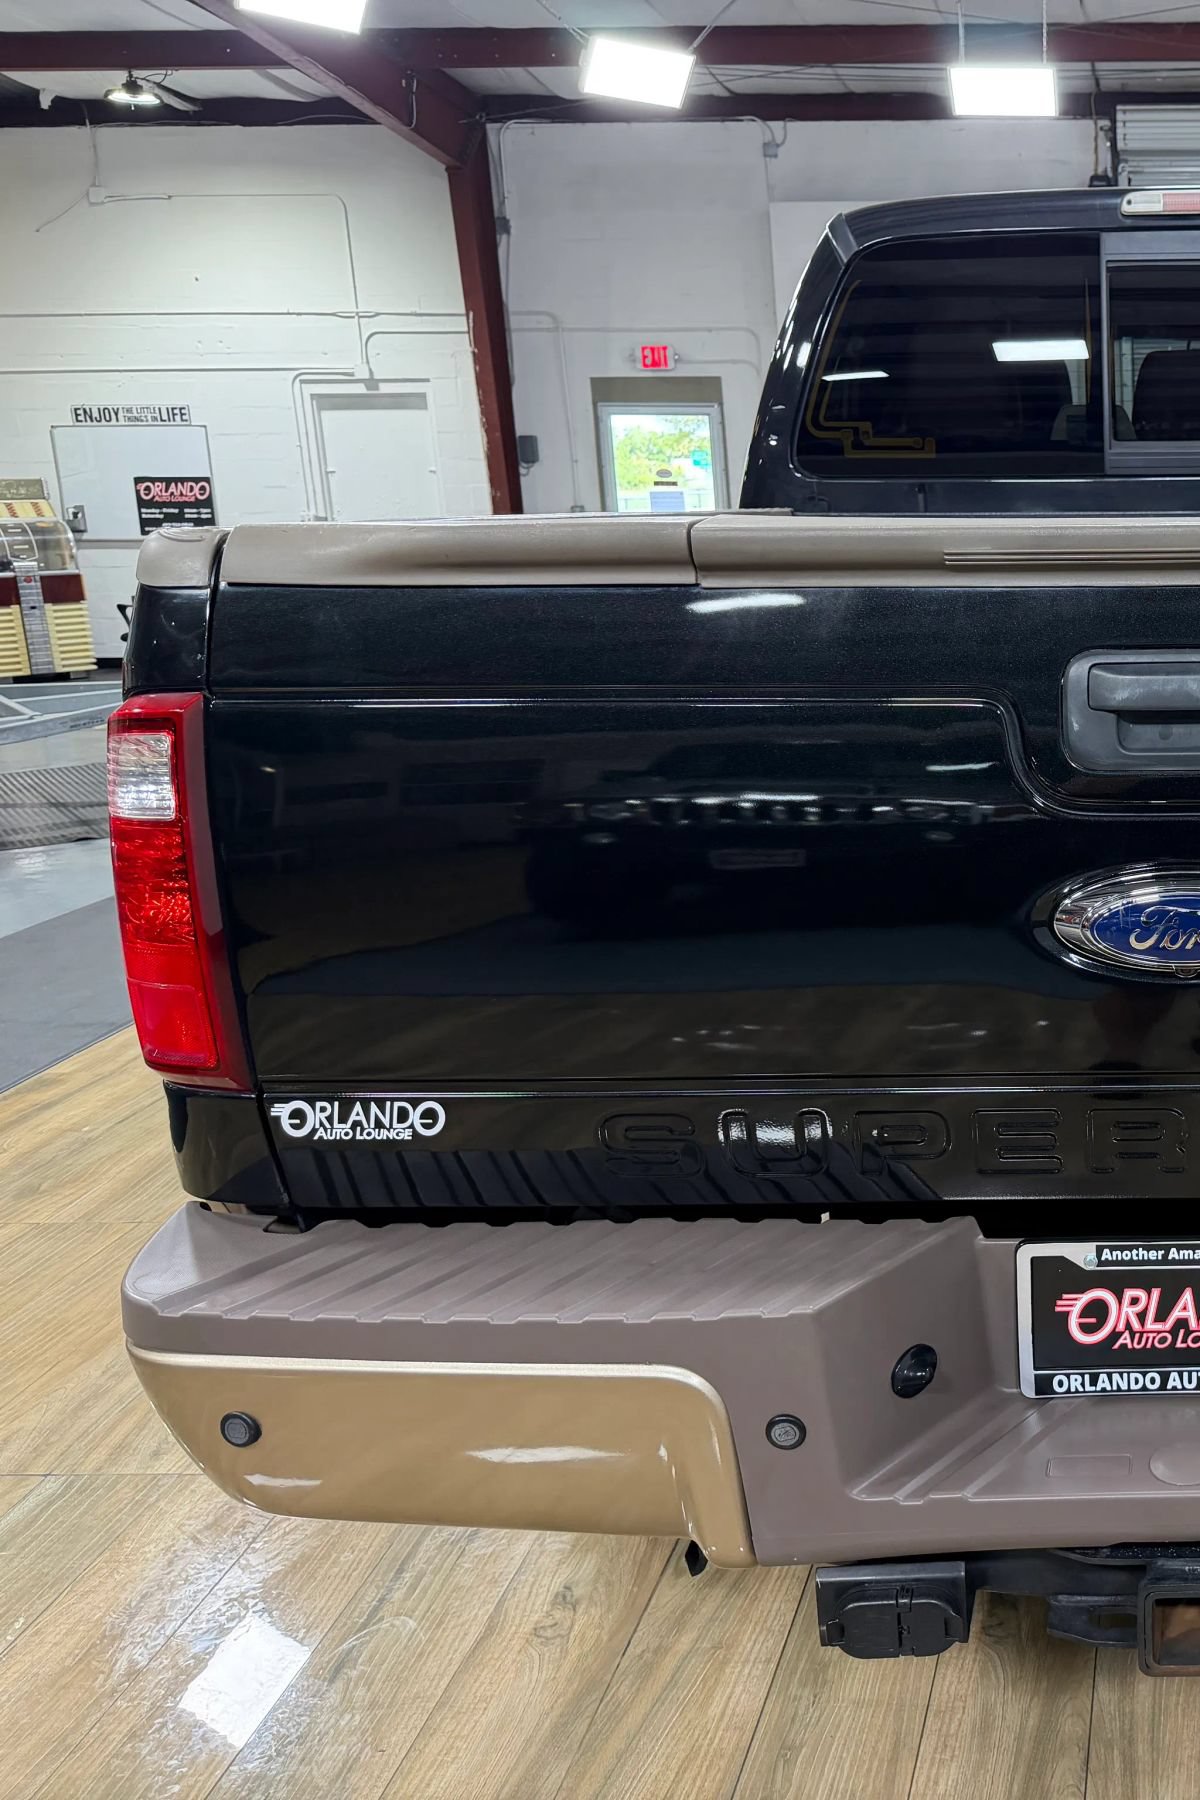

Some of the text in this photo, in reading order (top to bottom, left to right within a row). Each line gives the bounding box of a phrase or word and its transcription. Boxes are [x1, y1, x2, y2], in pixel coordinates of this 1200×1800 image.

[641, 346, 669, 369] EXIT
[73, 407, 120, 423] ENJOY
[158, 407, 189, 423] LIFE
[138, 481, 210, 500] ORLANDO
[277, 1100, 446, 1138] ORLANDO
[313, 1126, 413, 1140] AUTO LOUNGE
[598, 1106, 1191, 1178] SUPER
[1101, 1246, 1166, 1262] Another
[1111, 1330, 1173, 1350] AUTO
[1052, 1372, 1161, 1393] ORLANDO
